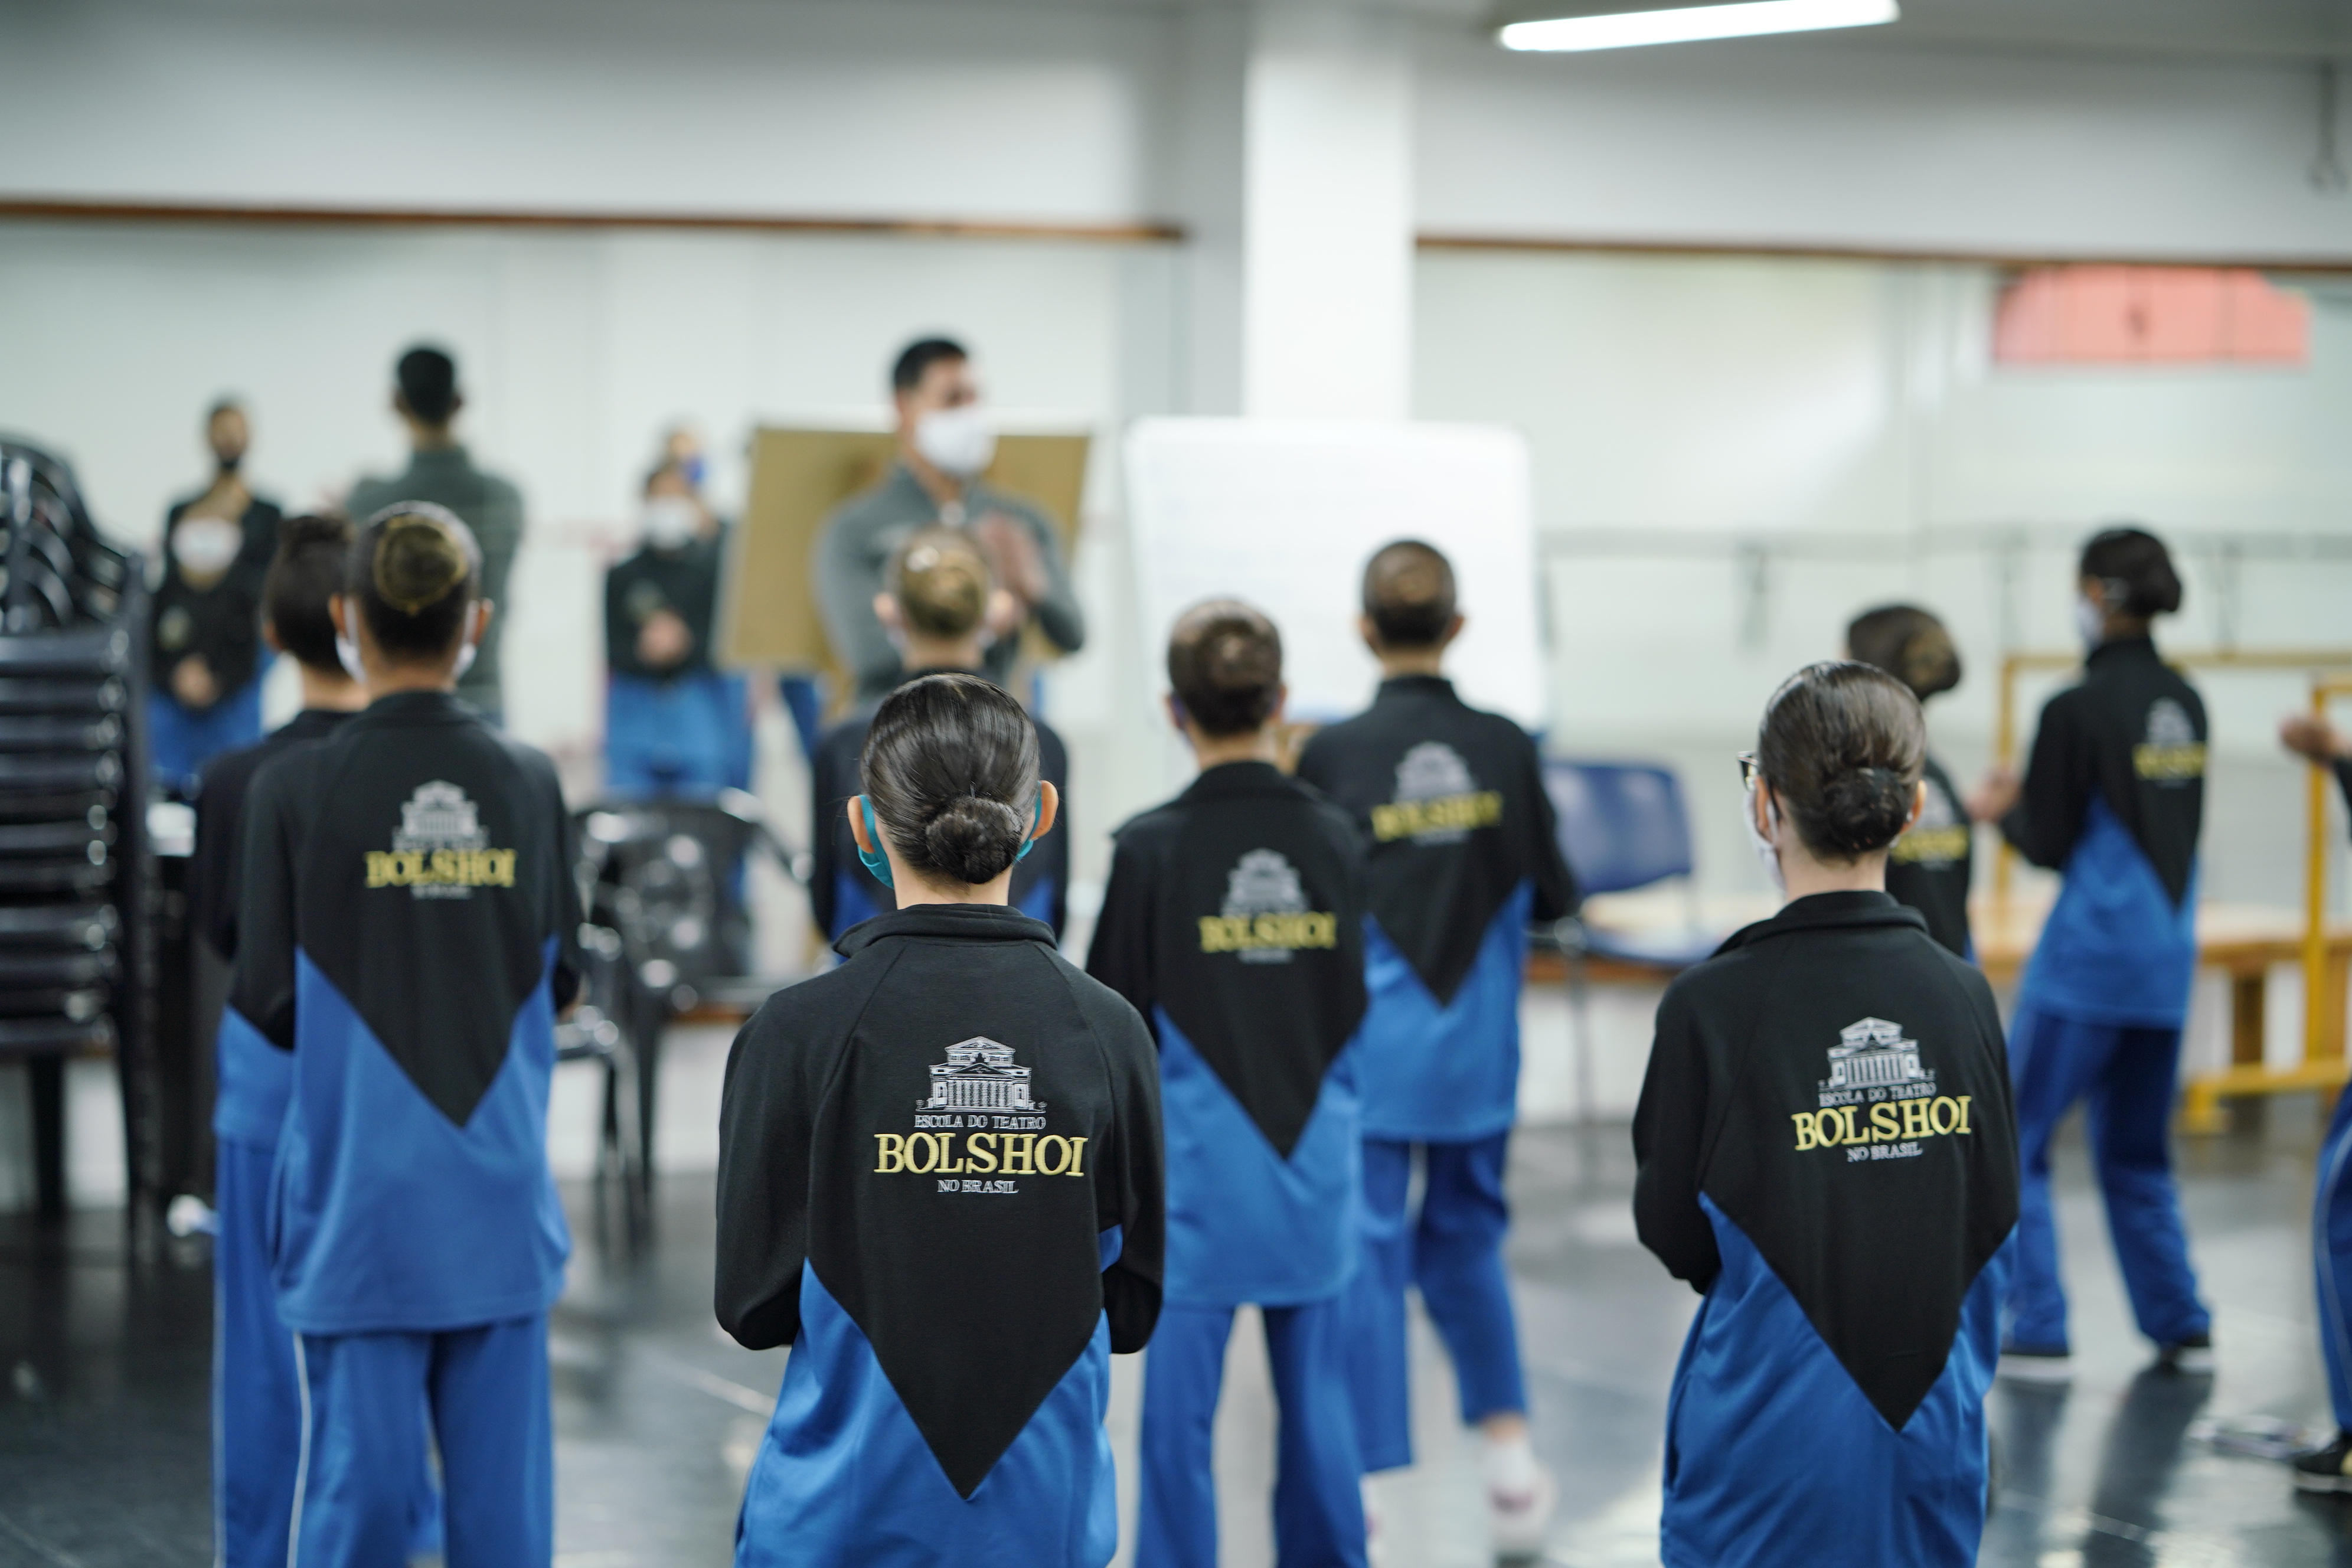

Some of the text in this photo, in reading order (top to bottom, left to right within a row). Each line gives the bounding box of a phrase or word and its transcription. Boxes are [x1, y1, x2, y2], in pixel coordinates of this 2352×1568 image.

[1819, 1082, 1937, 1107] ESCOLA DO TEATRO
[914, 1115, 1046, 1129] ESCOLA DO TEATRO
[1791, 1096, 1972, 1151] BOLSHOI
[874, 1132, 1088, 1177] BOLSHOI
[1847, 1142, 1923, 1162] NO BRASIL
[937, 1180, 1019, 1194] NO BRASIL
